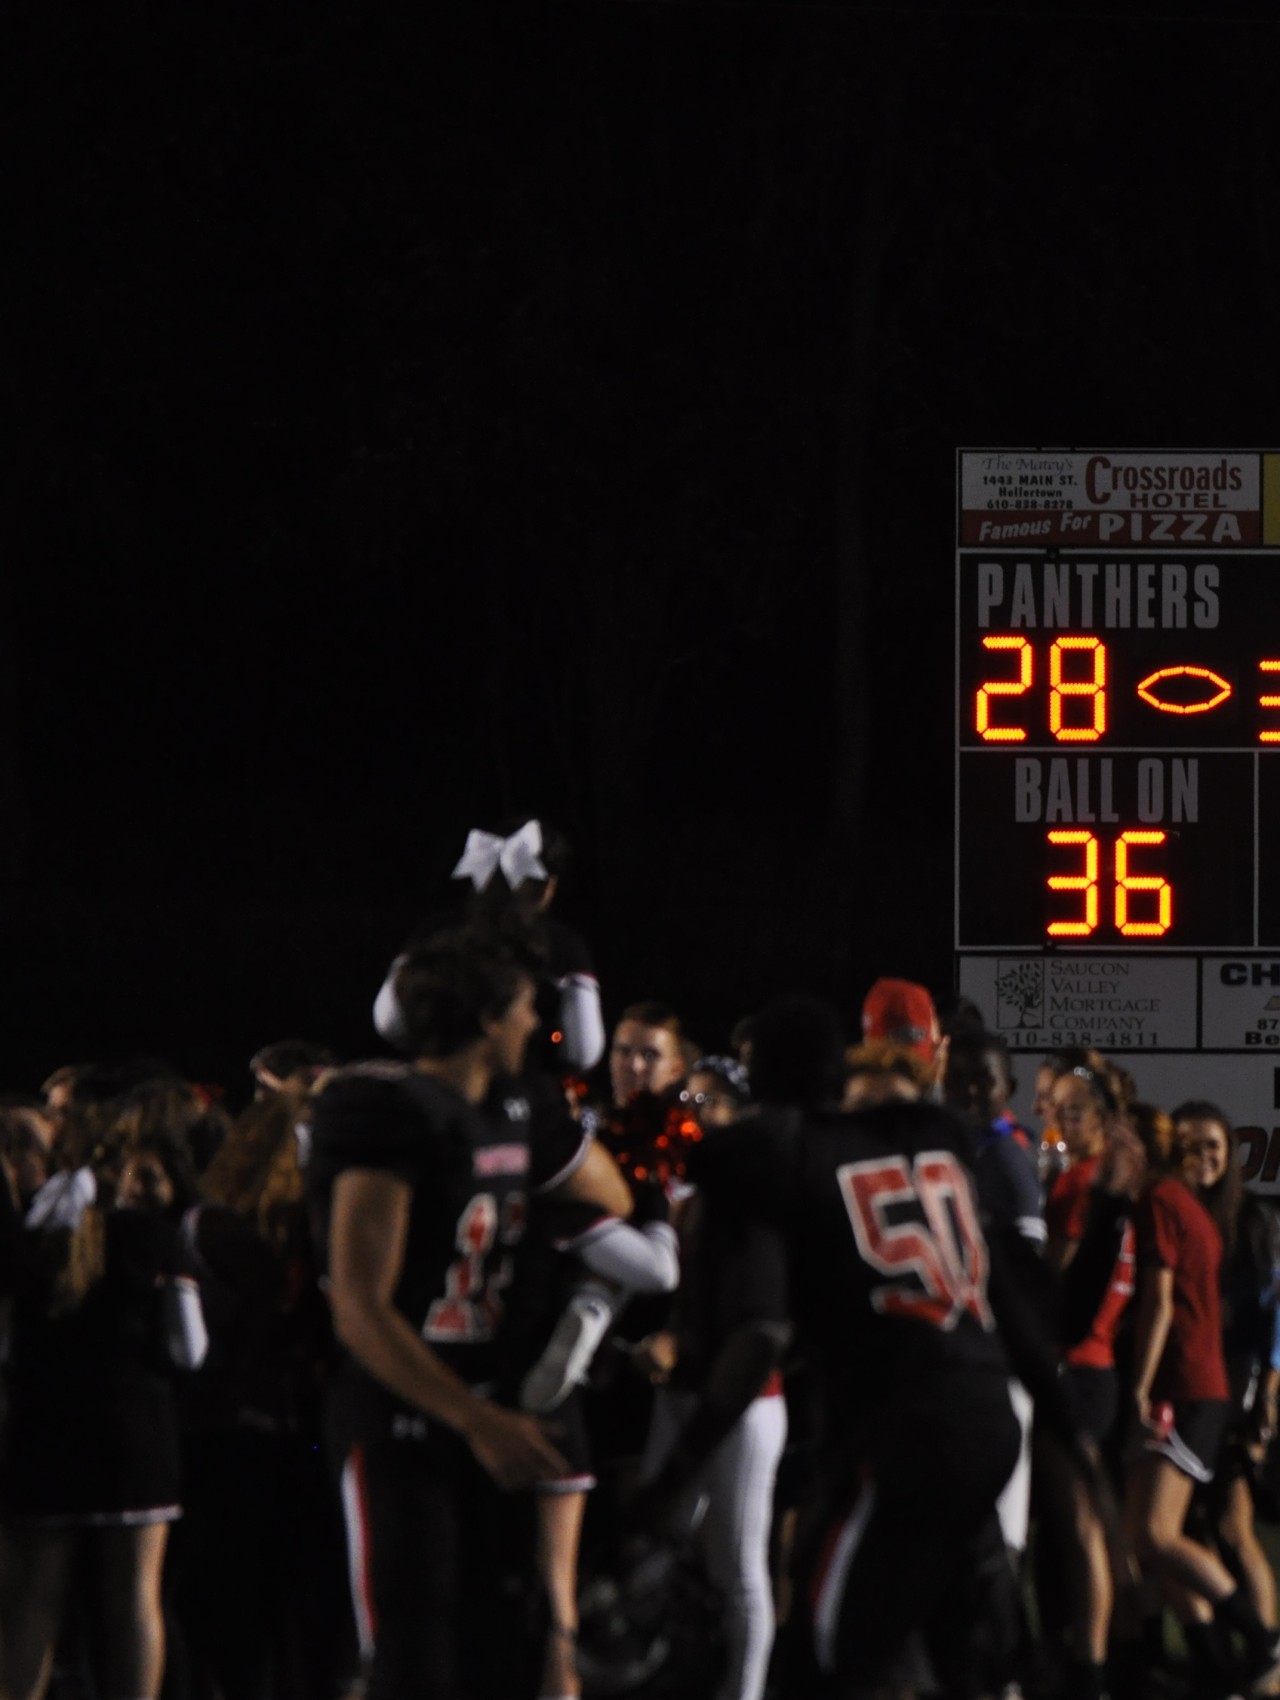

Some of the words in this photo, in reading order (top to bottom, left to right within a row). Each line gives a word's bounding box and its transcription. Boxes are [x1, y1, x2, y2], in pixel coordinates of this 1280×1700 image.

[983, 455, 1010, 470] The
[983, 476, 1013, 486] 1443
[1019, 476, 1053, 486] MAIN
[1059, 475, 1078, 486] ST.
[1085, 456, 1242, 504] Crossroads
[999, 487, 1062, 498] Hellertown
[1130, 493, 1227, 508] HOTEL
[979, 519, 1052, 542] Famous
[1060, 512, 1092, 532] For
[1098, 513, 1242, 543] PIZZA
[977, 563, 1220, 629] PANTHERS
[975, 635, 1108, 743] 28
[1014, 758, 1119, 823] BALL
[1137, 758, 1199, 824] ON
[1045, 829, 1173, 937] 36
[1051, 961, 1130, 976] SAUCON
[1051, 978, 1121, 994] VALLEY
[1051, 997, 1160, 1012] MORTGAGE
[1051, 1015, 1145, 1030] COMPANY
[836, 1150, 997, 1333] 50
